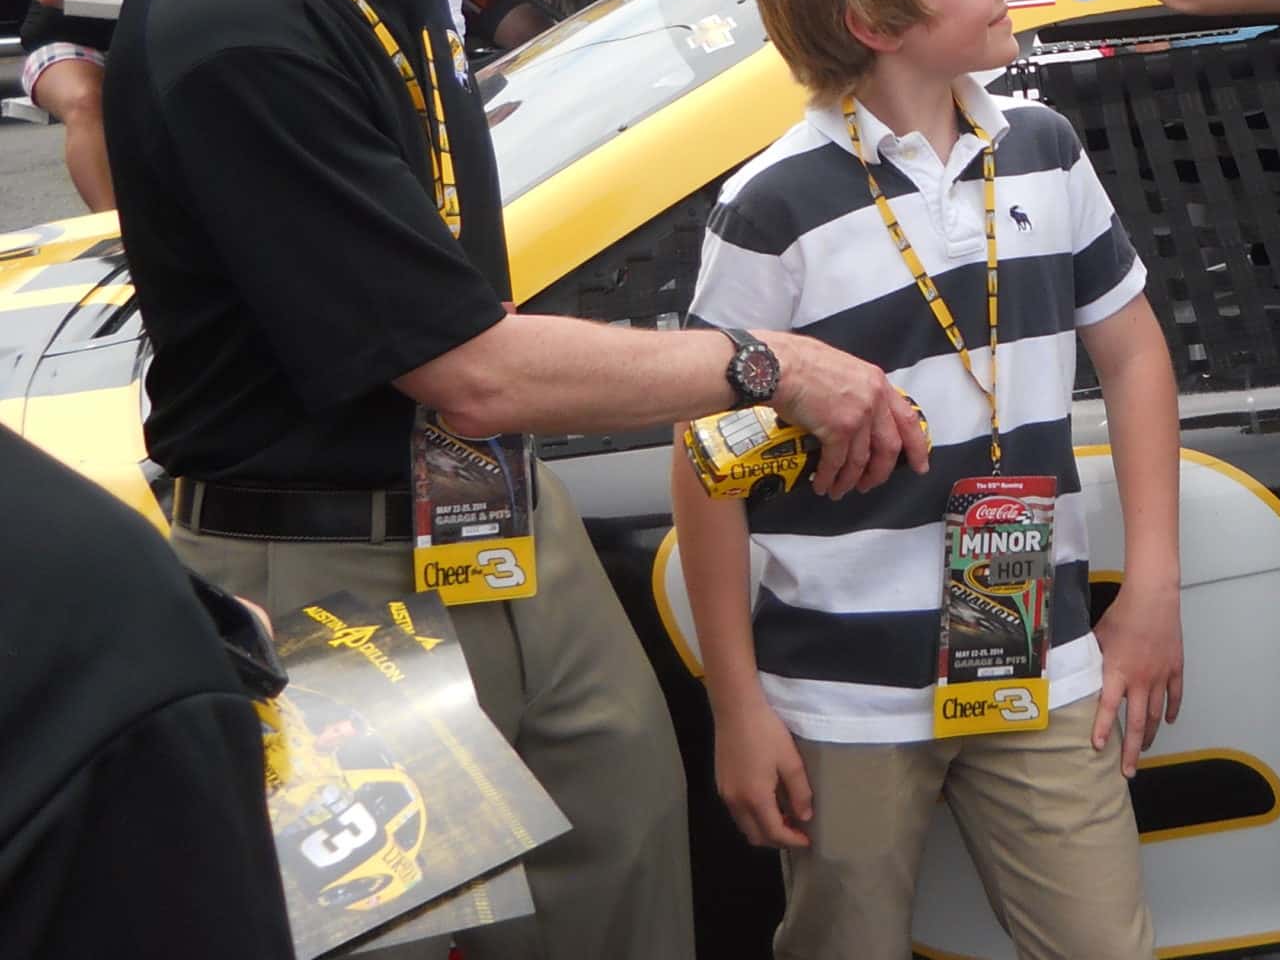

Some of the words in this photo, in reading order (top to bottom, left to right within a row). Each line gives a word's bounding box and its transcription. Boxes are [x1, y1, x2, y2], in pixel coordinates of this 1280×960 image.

[729, 456, 799, 480] Cheerios
[435, 512, 477, 525] GARAGE
[488, 509, 512, 520] PITS
[961, 530, 1042, 555] MINOR
[424, 561, 473, 589] Cheer
[476, 548, 526, 590] 3
[997, 560, 1034, 579] HOT
[303, 606, 348, 632] AUSTIN
[360, 642, 407, 683] DILLON
[1006, 655, 1028, 664] PITS
[942, 697, 987, 720] Cheer
[993, 687, 1041, 721] 3
[300, 802, 377, 869] 3
